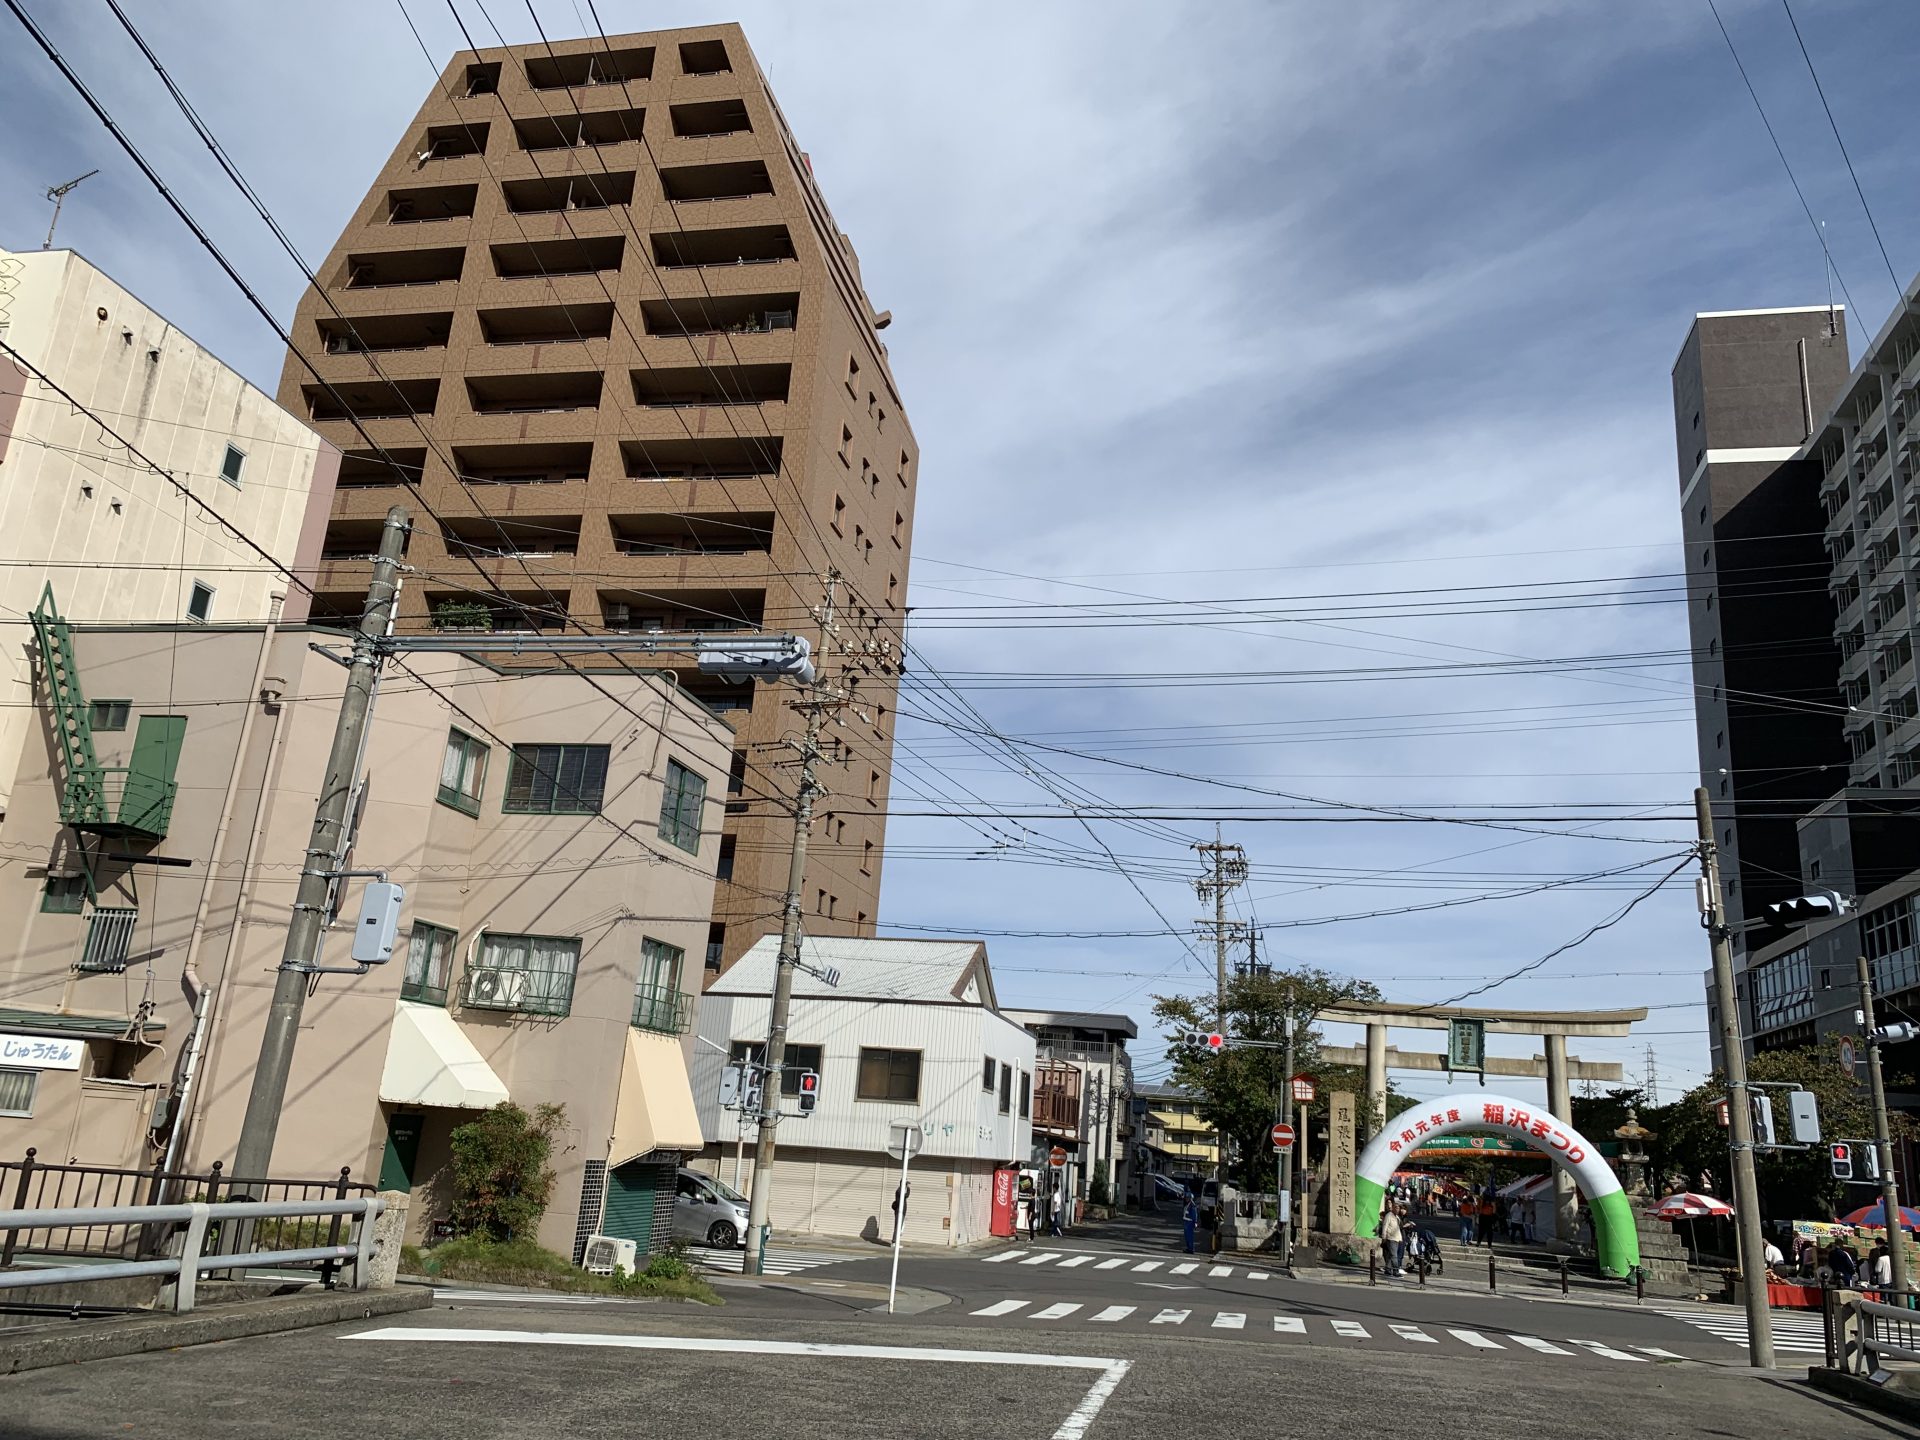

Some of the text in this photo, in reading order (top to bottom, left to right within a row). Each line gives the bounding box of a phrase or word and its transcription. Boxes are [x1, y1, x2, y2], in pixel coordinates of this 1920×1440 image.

[3, 1040, 72, 1060] じゅうたん
[1389, 1109, 1461, 1153] 令和元年度
[1482, 1103, 1585, 1164] 稲沢まつり
[996, 1171, 1009, 1206] Coca-Cola
